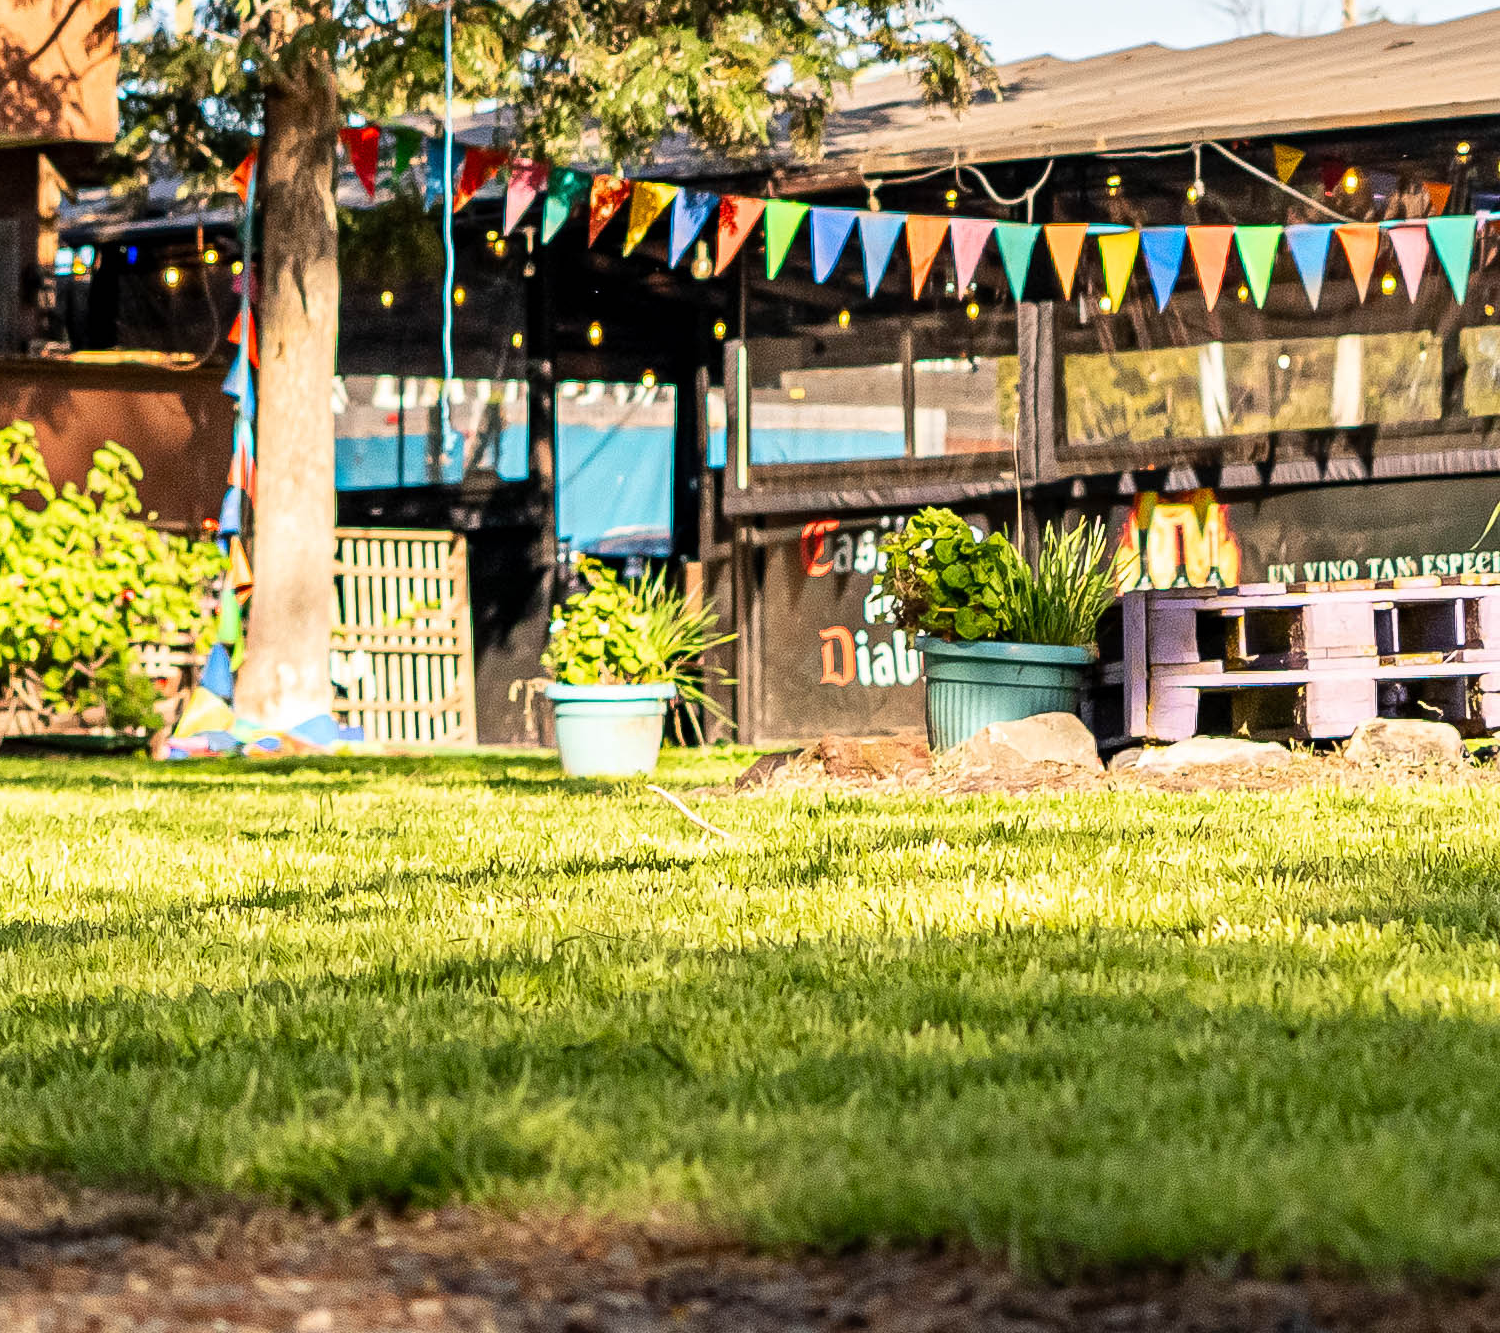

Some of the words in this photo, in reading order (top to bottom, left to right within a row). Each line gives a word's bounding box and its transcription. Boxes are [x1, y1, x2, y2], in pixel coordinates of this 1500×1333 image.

[1267, 564, 1295, 583] UN
[1303, 560, 1359, 582] VINO
[819, 626, 924, 686] Diab
